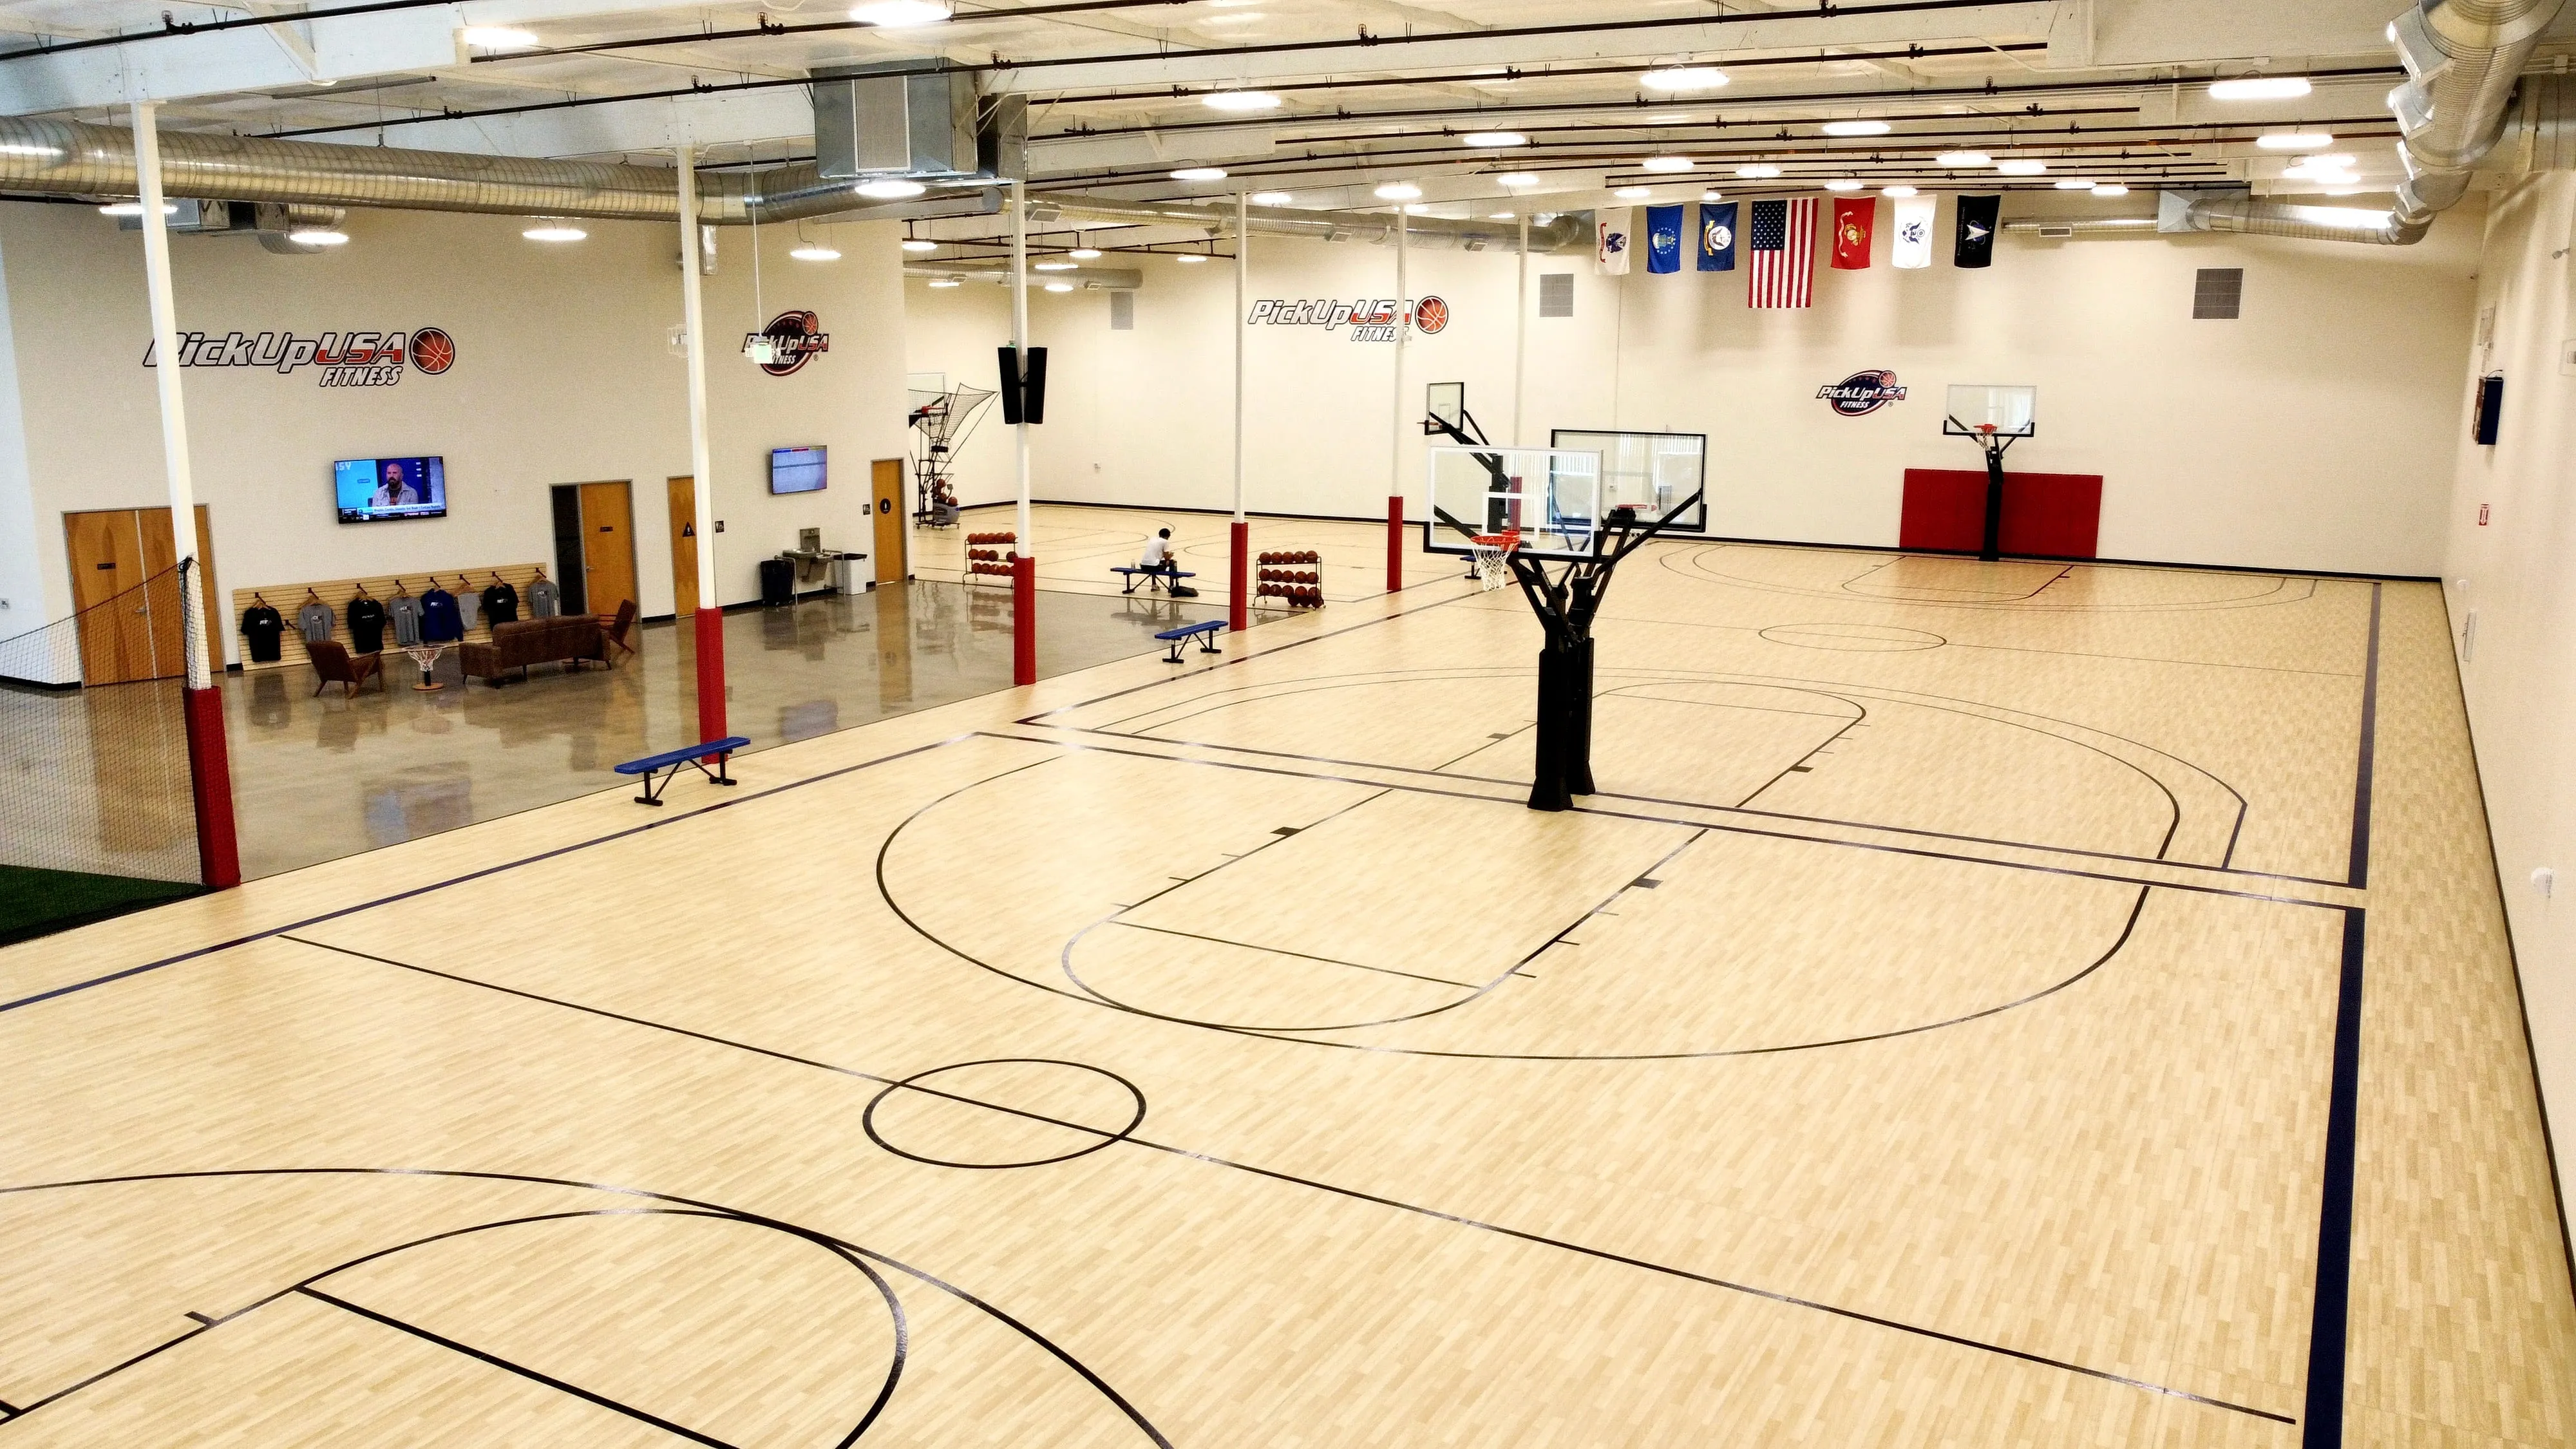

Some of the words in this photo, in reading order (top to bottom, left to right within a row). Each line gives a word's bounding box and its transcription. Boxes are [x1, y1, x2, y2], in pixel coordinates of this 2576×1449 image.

[1247, 299, 1414, 330] PickUpUSA
[744, 334, 829, 354] PkUpUSA
[319, 366, 404, 387] FITNESS
[1817, 386, 1906, 401] PickUpUSA
